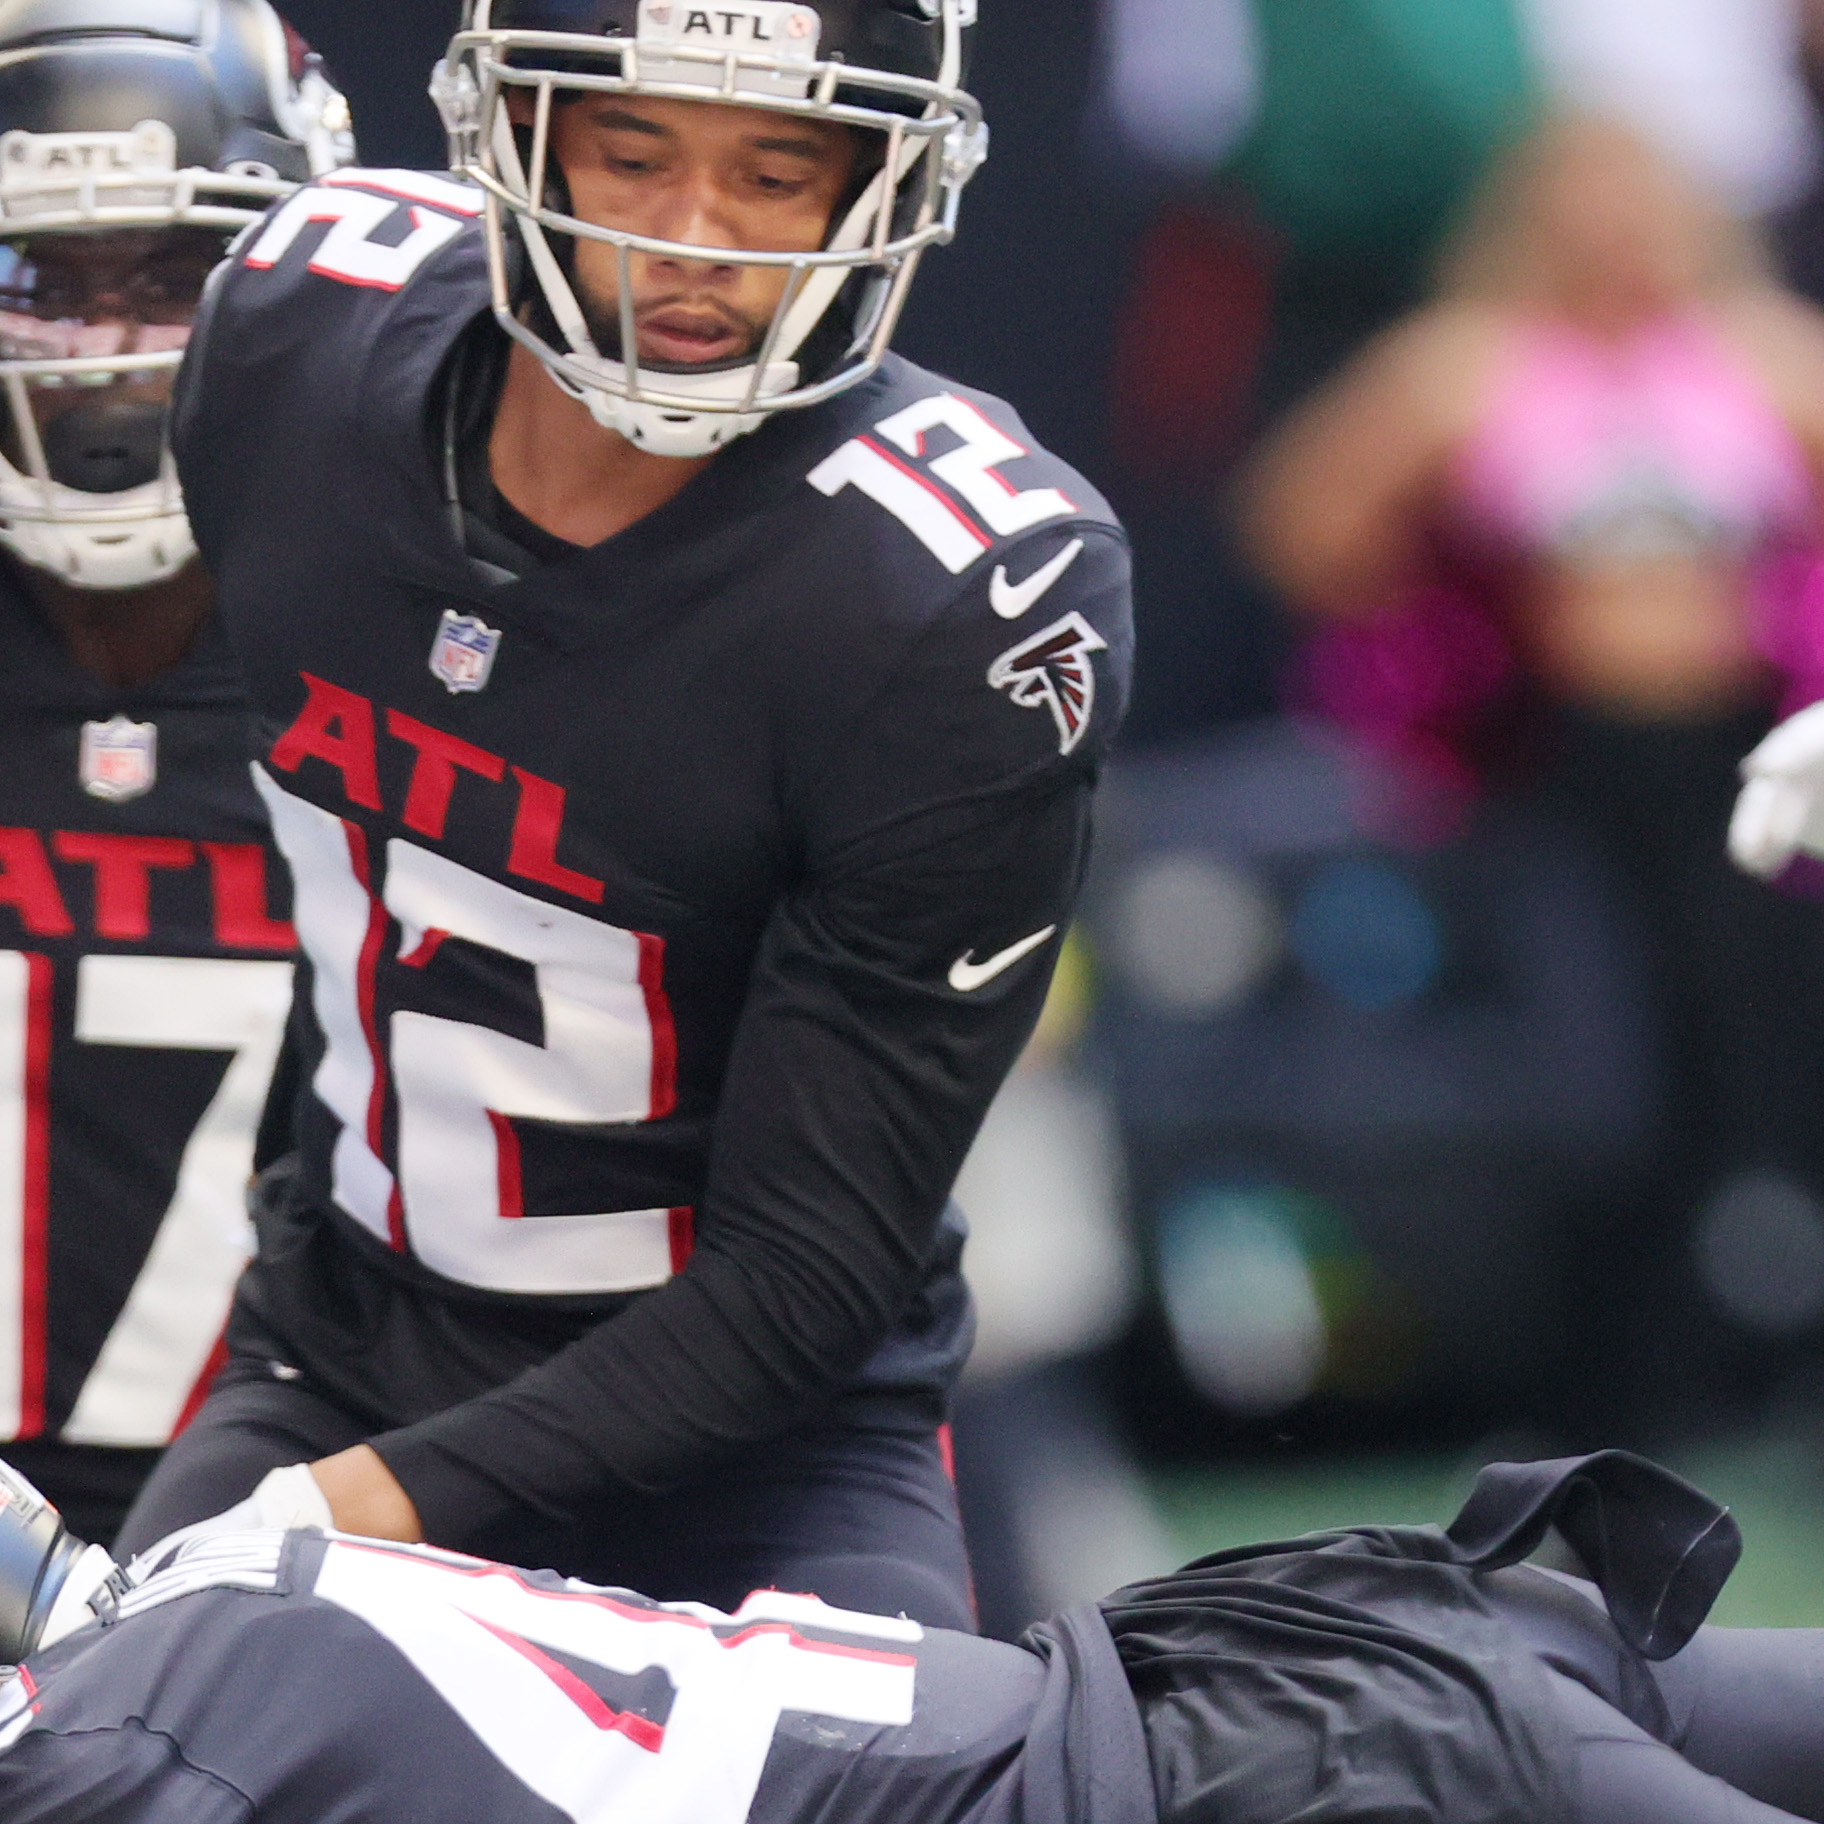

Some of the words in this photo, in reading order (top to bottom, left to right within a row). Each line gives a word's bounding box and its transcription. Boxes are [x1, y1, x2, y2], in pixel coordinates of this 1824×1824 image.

[683, 10, 771, 40] ATL
[805, 394, 1080, 576] 12
[268, 670, 606, 904] ATL
[250, 760, 696, 1296] 12
